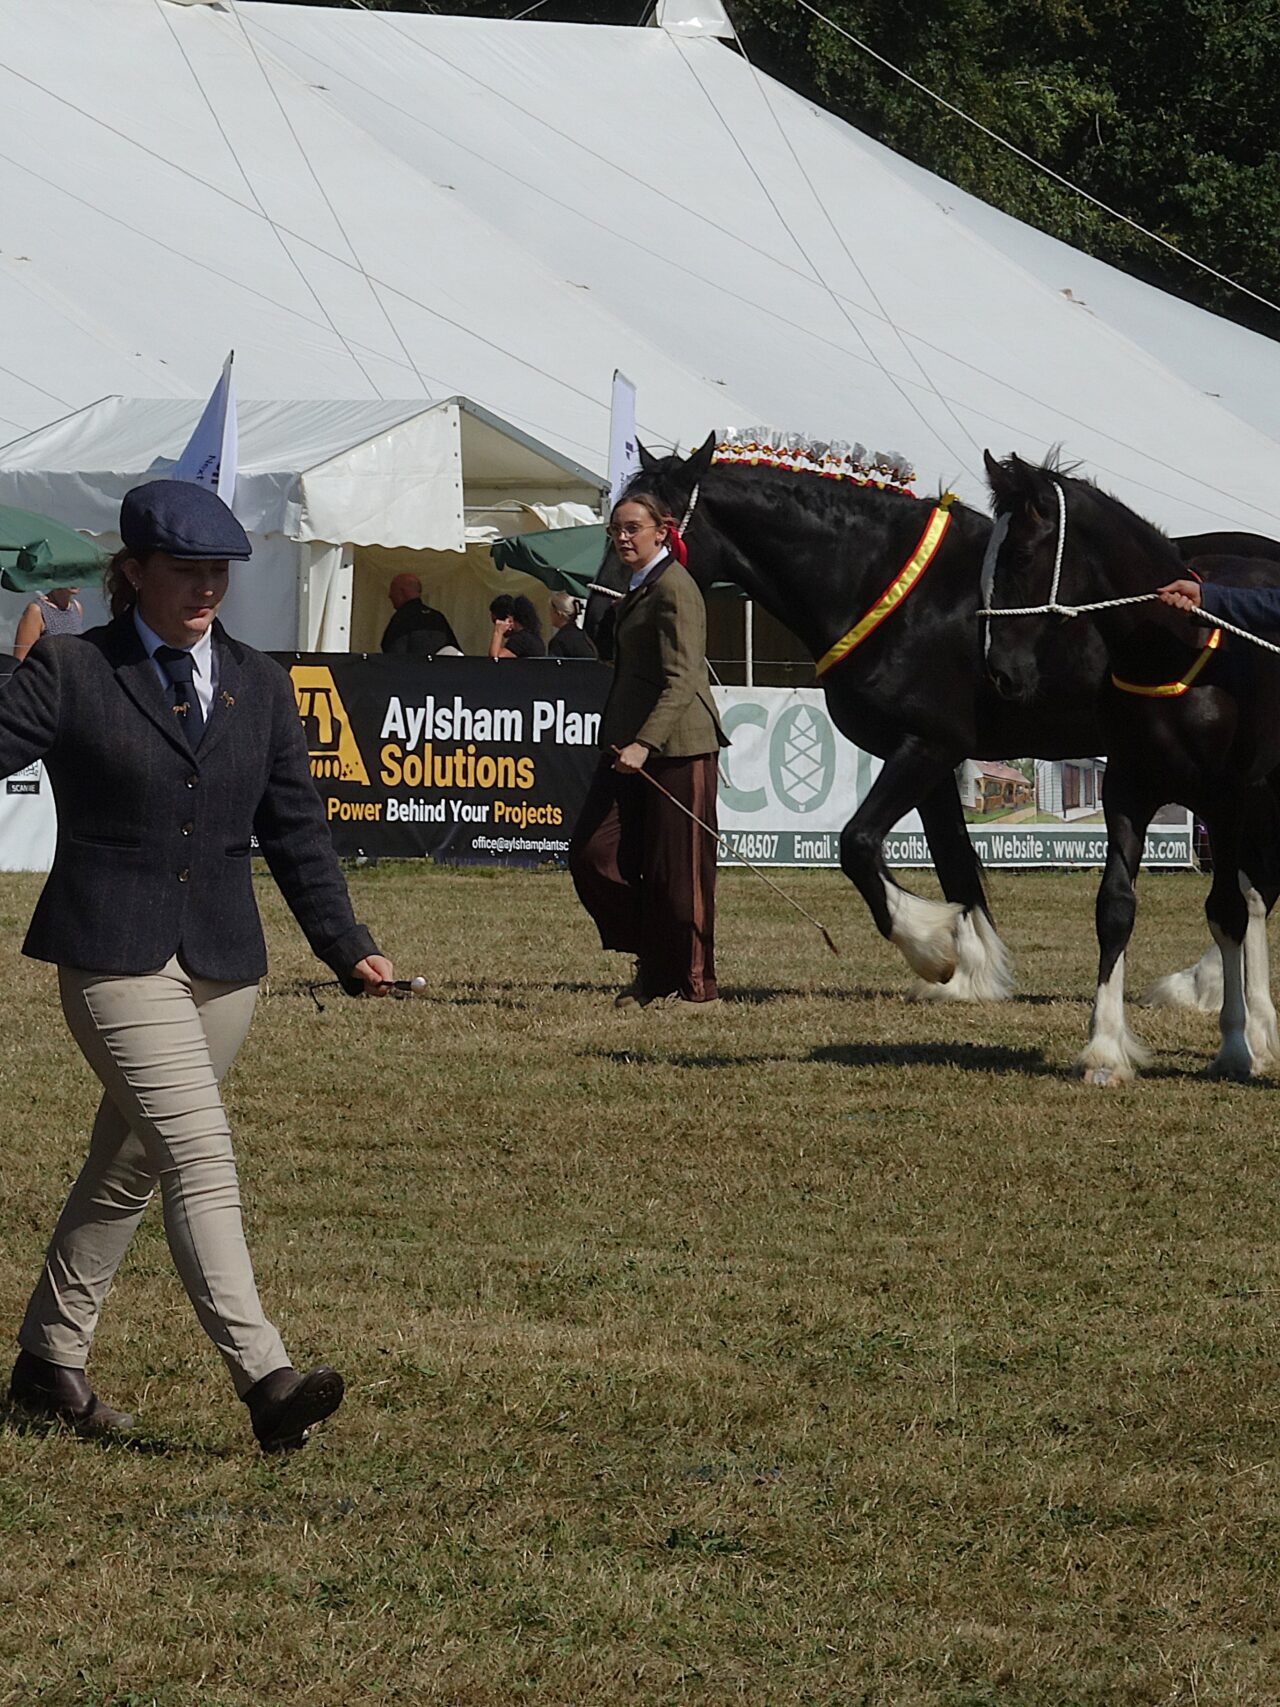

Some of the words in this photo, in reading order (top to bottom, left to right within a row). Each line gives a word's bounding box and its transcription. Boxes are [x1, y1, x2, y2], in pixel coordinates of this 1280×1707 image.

[380, 695, 524, 752] Aylsham
[532, 698, 603, 746] Plan
[380, 743, 535, 789] Solutions
[327, 797, 382, 823] Power
[385, 798, 446, 823] Behind
[449, 799, 490, 823] Your
[493, 801, 563, 829] Projects
[731, 833, 780, 859] 748507
[794, 835, 831, 859] Email
[991, 834, 1044, 859] Website
